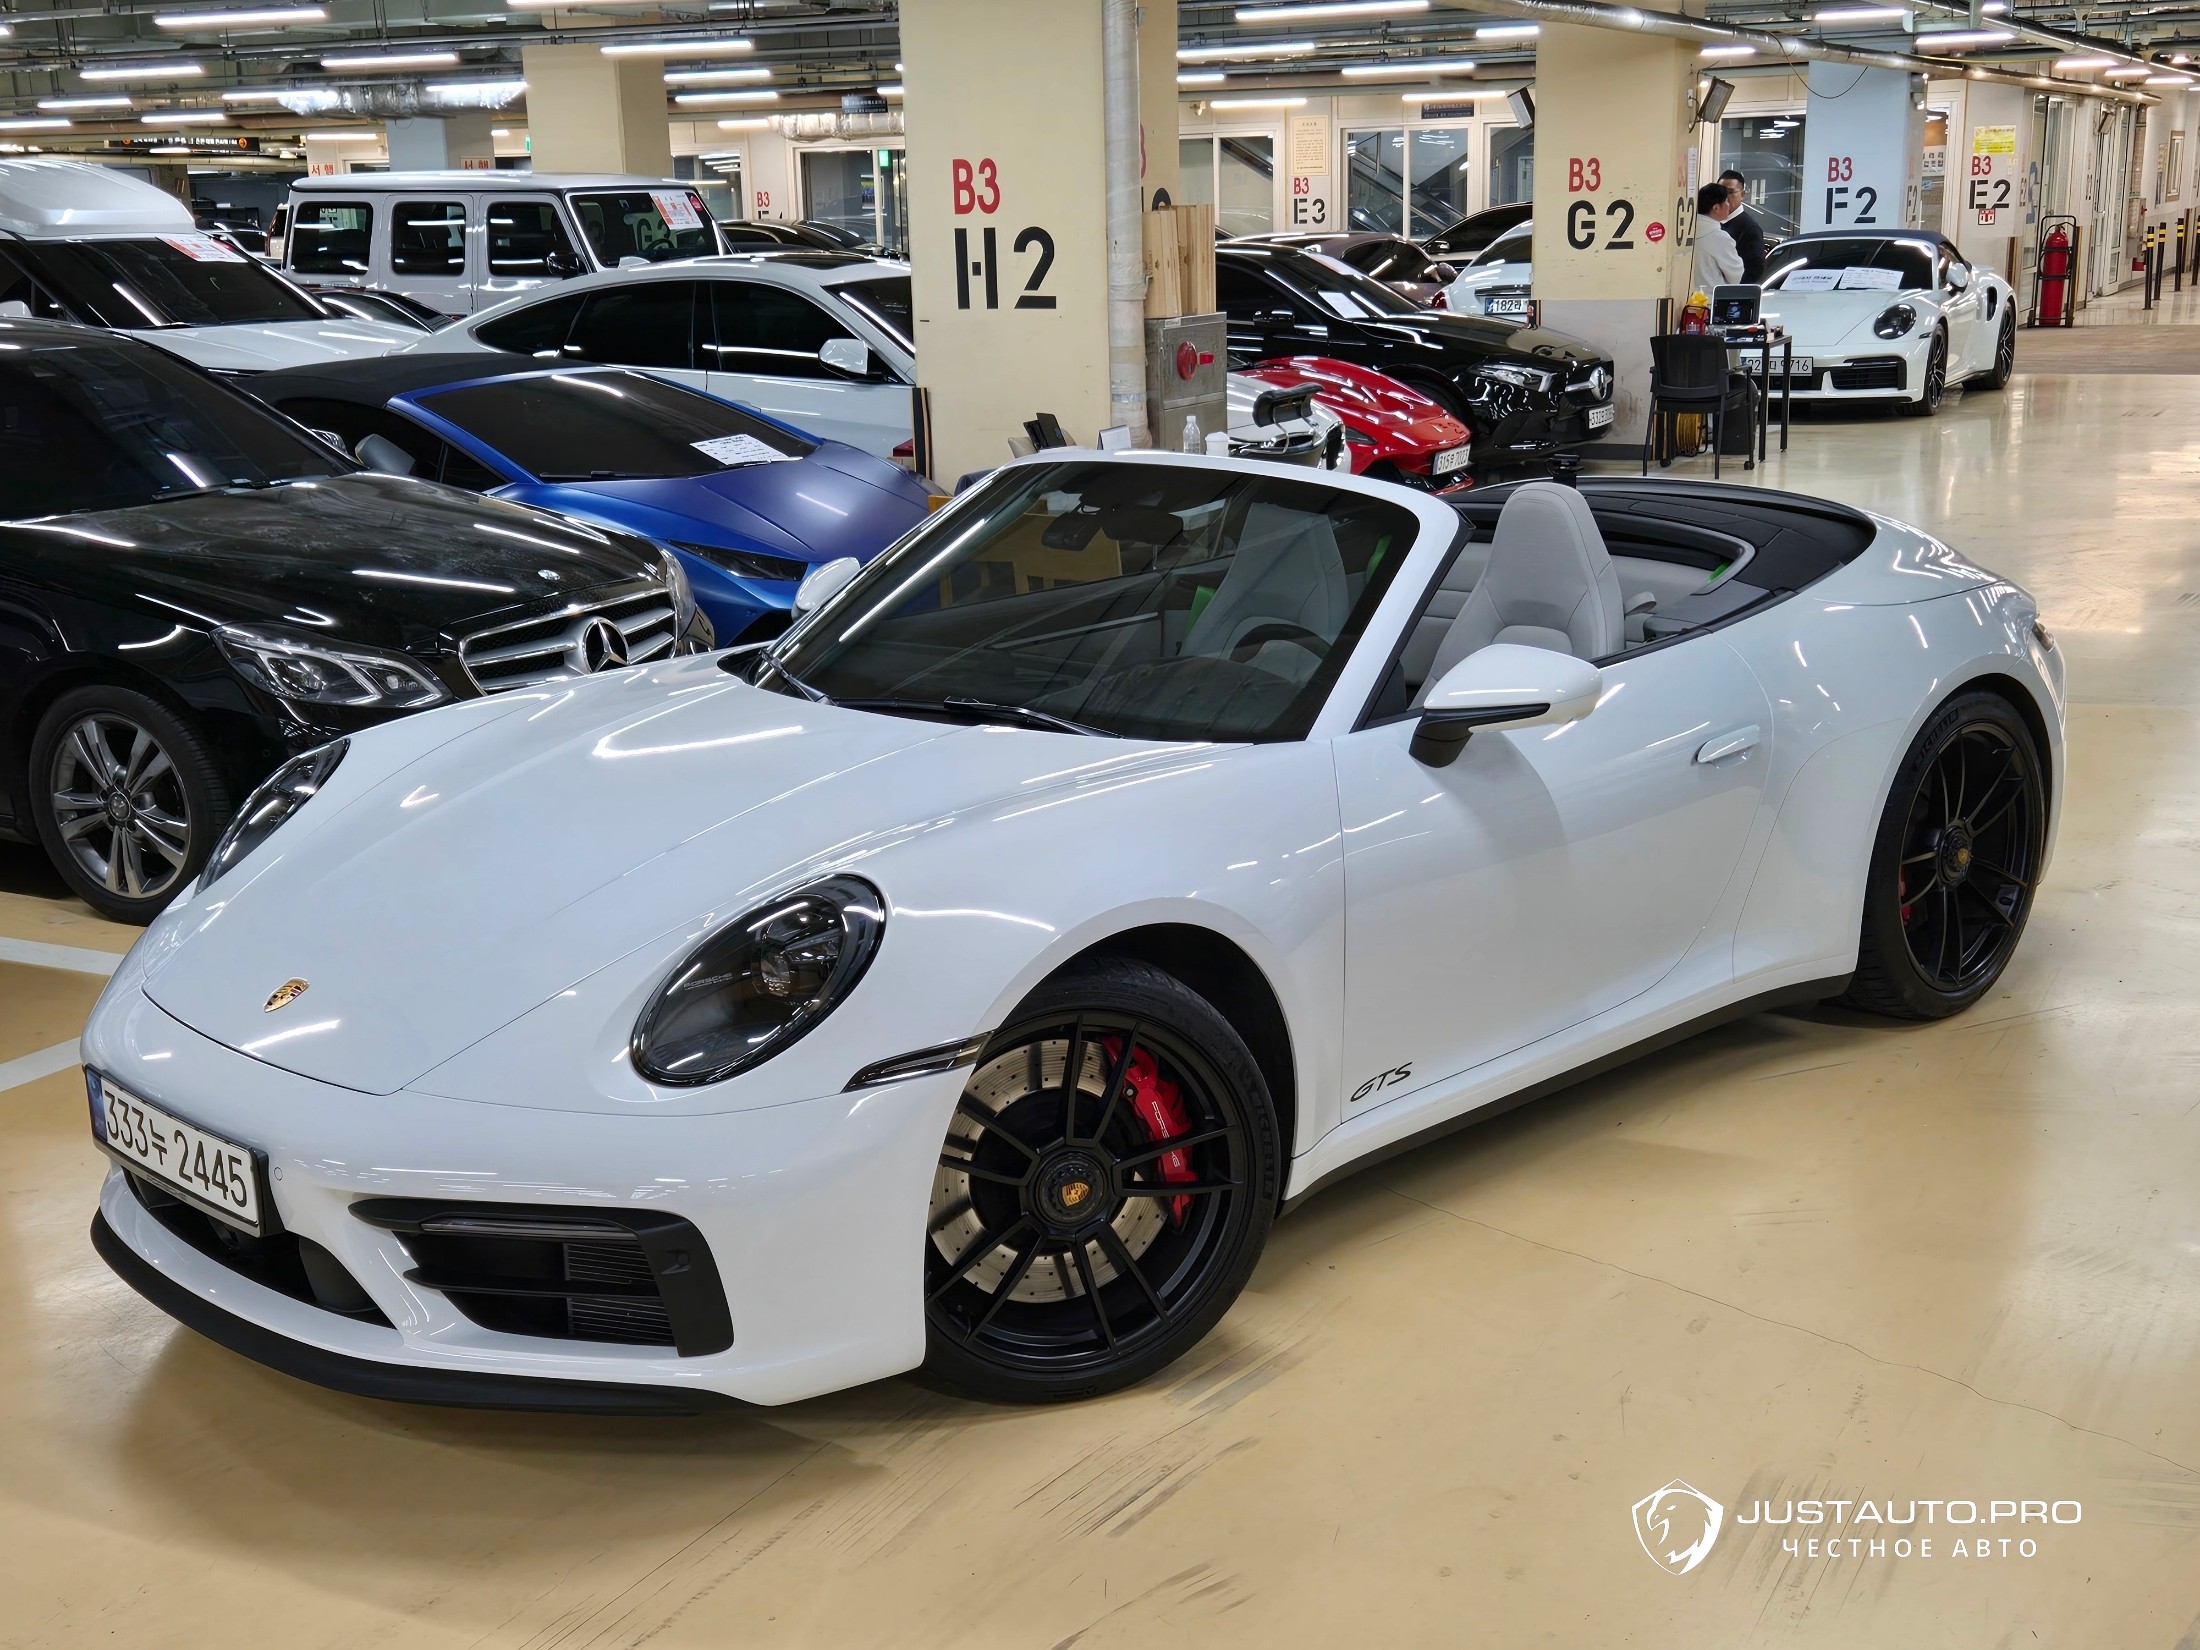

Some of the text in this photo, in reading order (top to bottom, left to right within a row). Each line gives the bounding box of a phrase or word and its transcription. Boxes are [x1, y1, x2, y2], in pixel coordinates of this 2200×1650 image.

[1569, 157, 1601, 192] B3
[1828, 156, 1853, 182] B3
[1971, 155, 1992, 176] B3
[757, 192, 770, 208] B3
[953, 158, 1001, 214] B3
[1294, 177, 1309, 195] B3
[1969, 179, 2011, 209] E2
[1294, 198, 1325, 224] E3
[1825, 186, 1877, 224] F2
[1567, 199, 1635, 250] G2
[954, 226, 1057, 309] H2
[1350, 1061, 1412, 1102] GTS
[105, 1090, 247, 1208] 333누 2445
